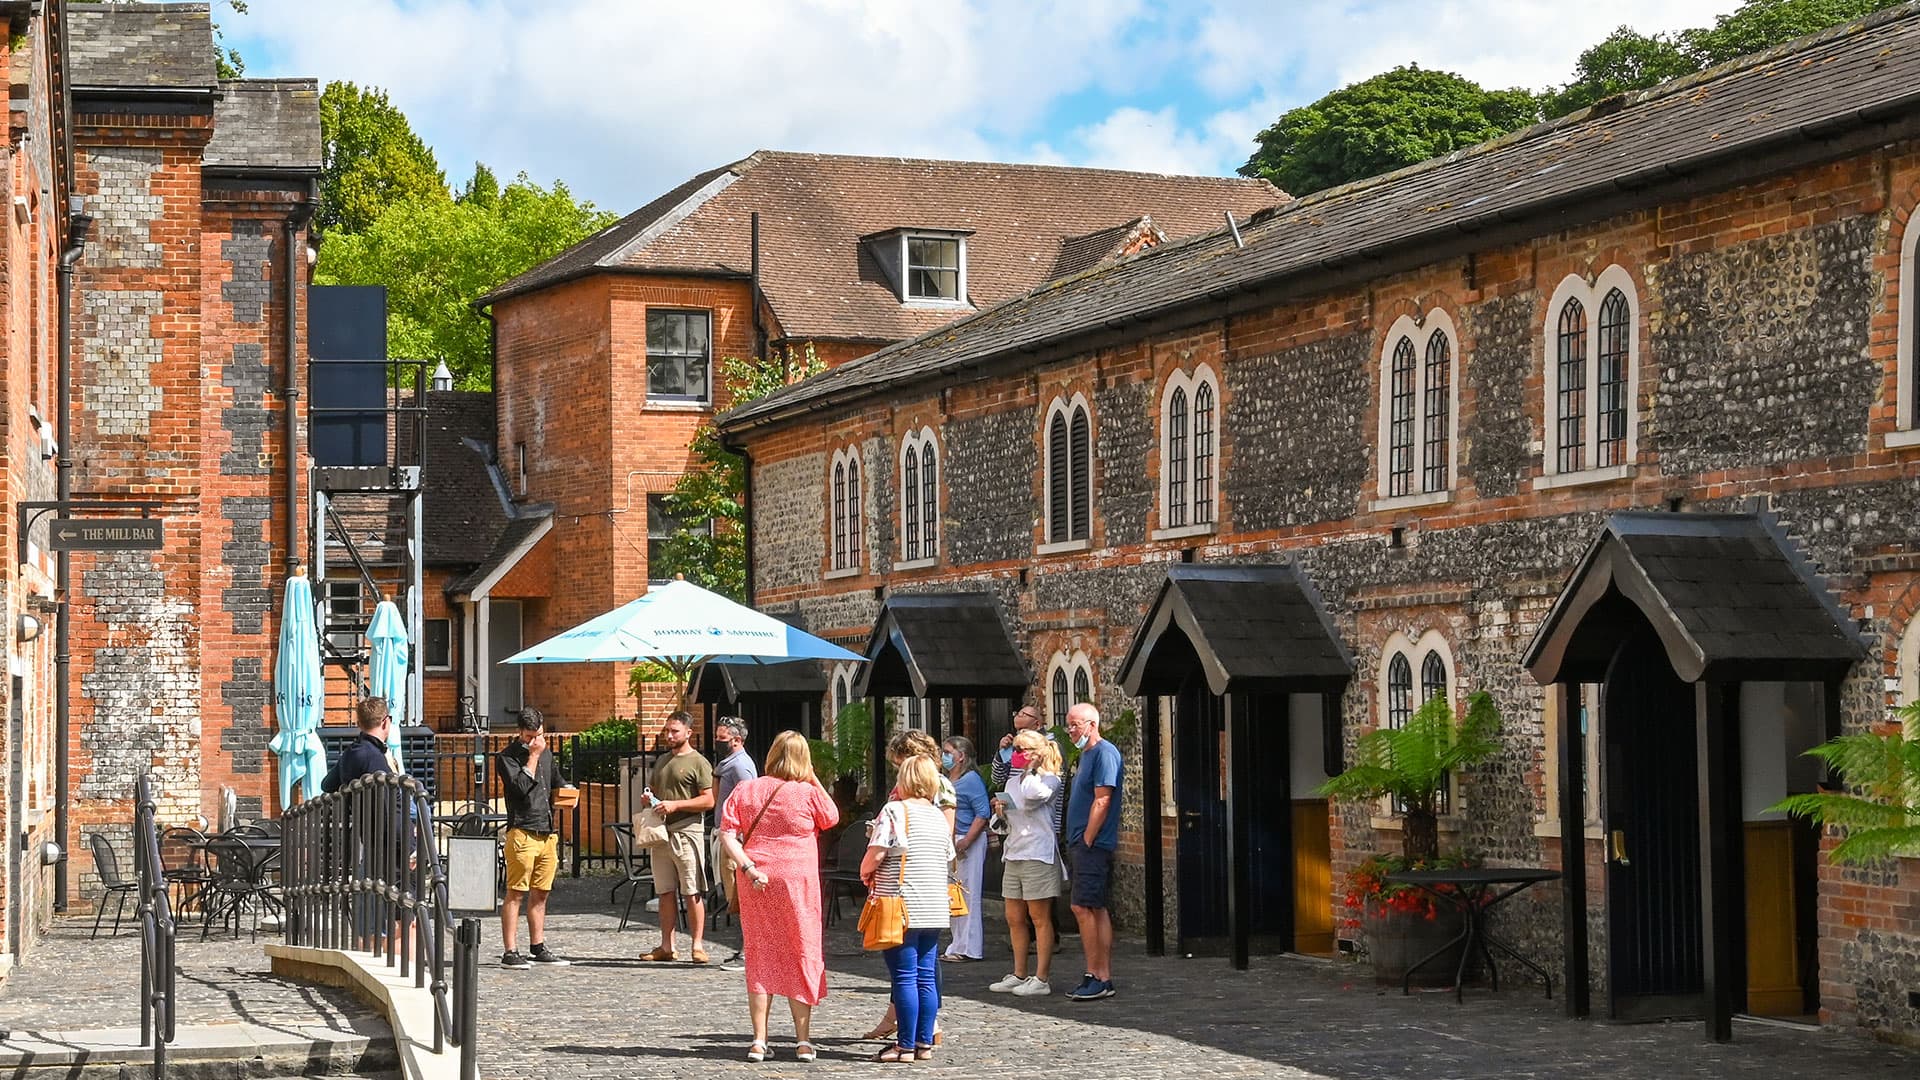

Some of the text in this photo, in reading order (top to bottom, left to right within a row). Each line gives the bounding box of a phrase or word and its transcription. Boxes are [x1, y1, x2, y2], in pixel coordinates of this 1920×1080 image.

[81, 527, 155, 540] THE MILL BAR
[726, 629, 776, 638] SAPPHIRE
